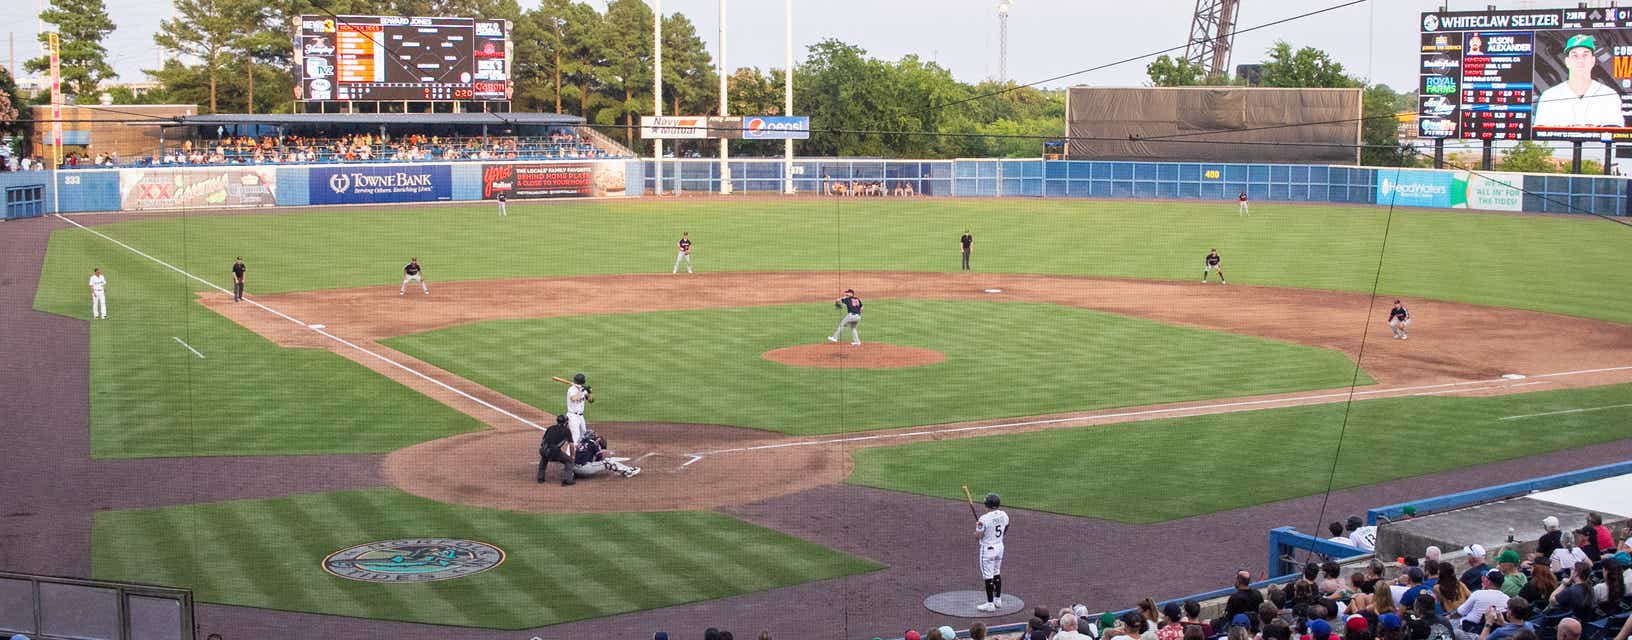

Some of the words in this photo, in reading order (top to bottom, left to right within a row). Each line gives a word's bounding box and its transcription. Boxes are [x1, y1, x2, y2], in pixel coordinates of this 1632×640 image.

[324, 18, 335, 32] 3
[381, 17, 409, 26] EDWARD
[410, 17, 432, 26] JONES
[1440, 16, 1510, 27] WHITECLAW
[1511, 15, 1559, 26] SELTZER
[1488, 36, 1514, 45] JASON
[1487, 43, 1532, 52] ALEXANDER
[1426, 77, 1456, 85] ROYAL
[474, 82, 504, 91] Canon
[1425, 85, 1456, 94] FARMS
[653, 118, 679, 127] Navy
[660, 127, 696, 135] Mutual
[767, 121, 802, 134] pepsi
[1205, 170, 1220, 178] 400
[64, 175, 80, 185] 333
[137, 183, 170, 199] XX
[1390, 183, 1446, 194] HeadWaters
[995, 524, 1002, 538] 5
[1365, 533, 1376, 546] 13
